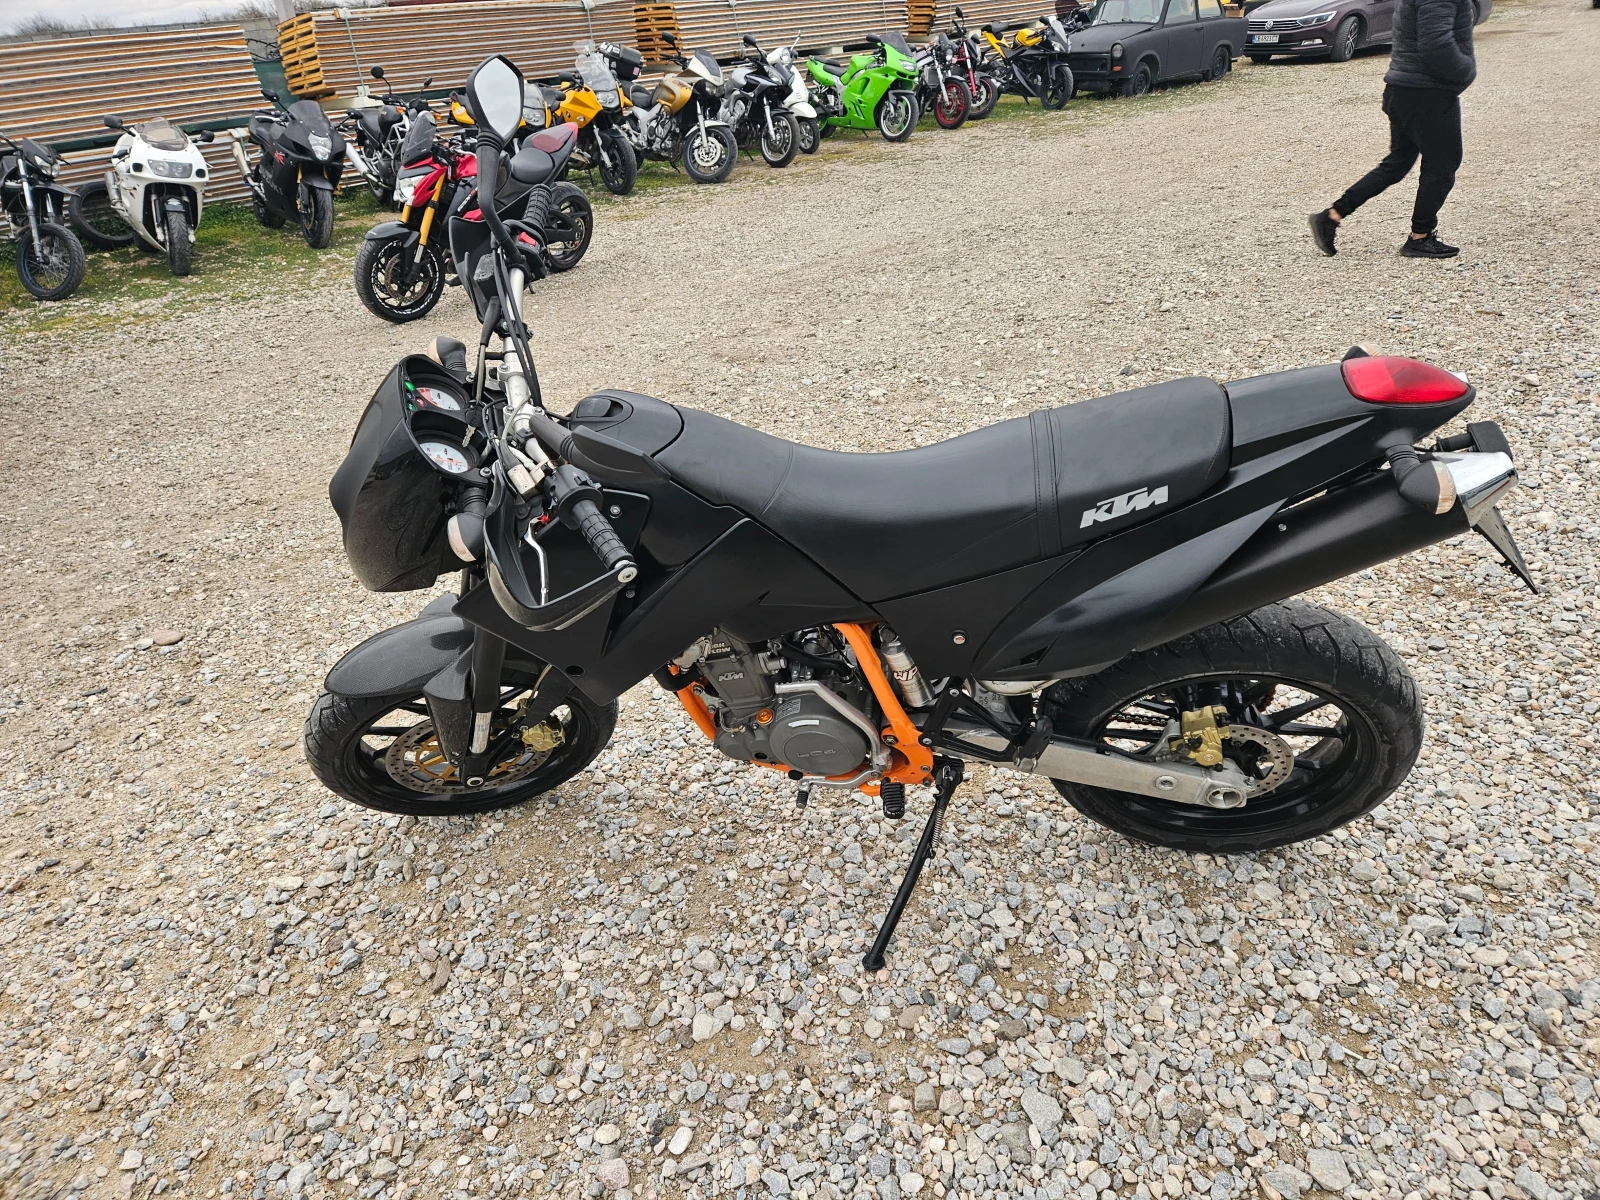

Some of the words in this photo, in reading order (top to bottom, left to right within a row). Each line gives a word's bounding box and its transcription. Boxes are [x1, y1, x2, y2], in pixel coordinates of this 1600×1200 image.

[1079, 484, 1169, 529] KTM
[711, 646, 731, 654] LOW
[718, 671, 744, 682] KTM
[893, 665, 918, 681] WP
